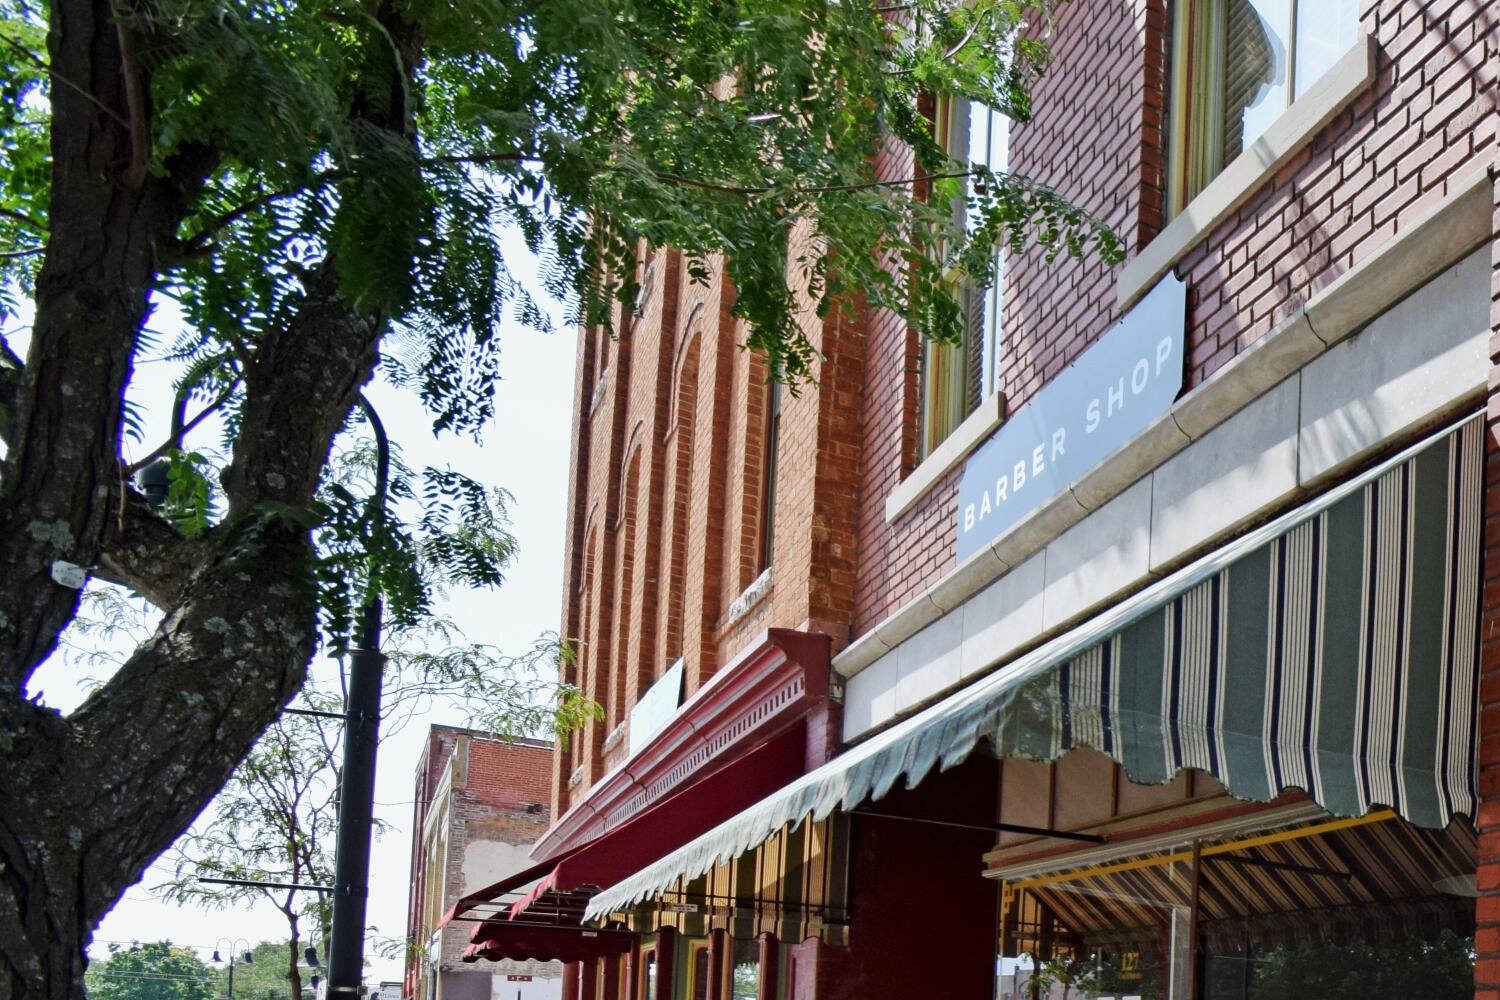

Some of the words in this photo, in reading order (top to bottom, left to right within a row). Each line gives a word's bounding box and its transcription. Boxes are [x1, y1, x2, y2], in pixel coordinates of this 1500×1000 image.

[963, 426, 1066, 534] BARBER
[1085, 335, 1173, 434] SHOP
[1121, 951, 1140, 971] 127
